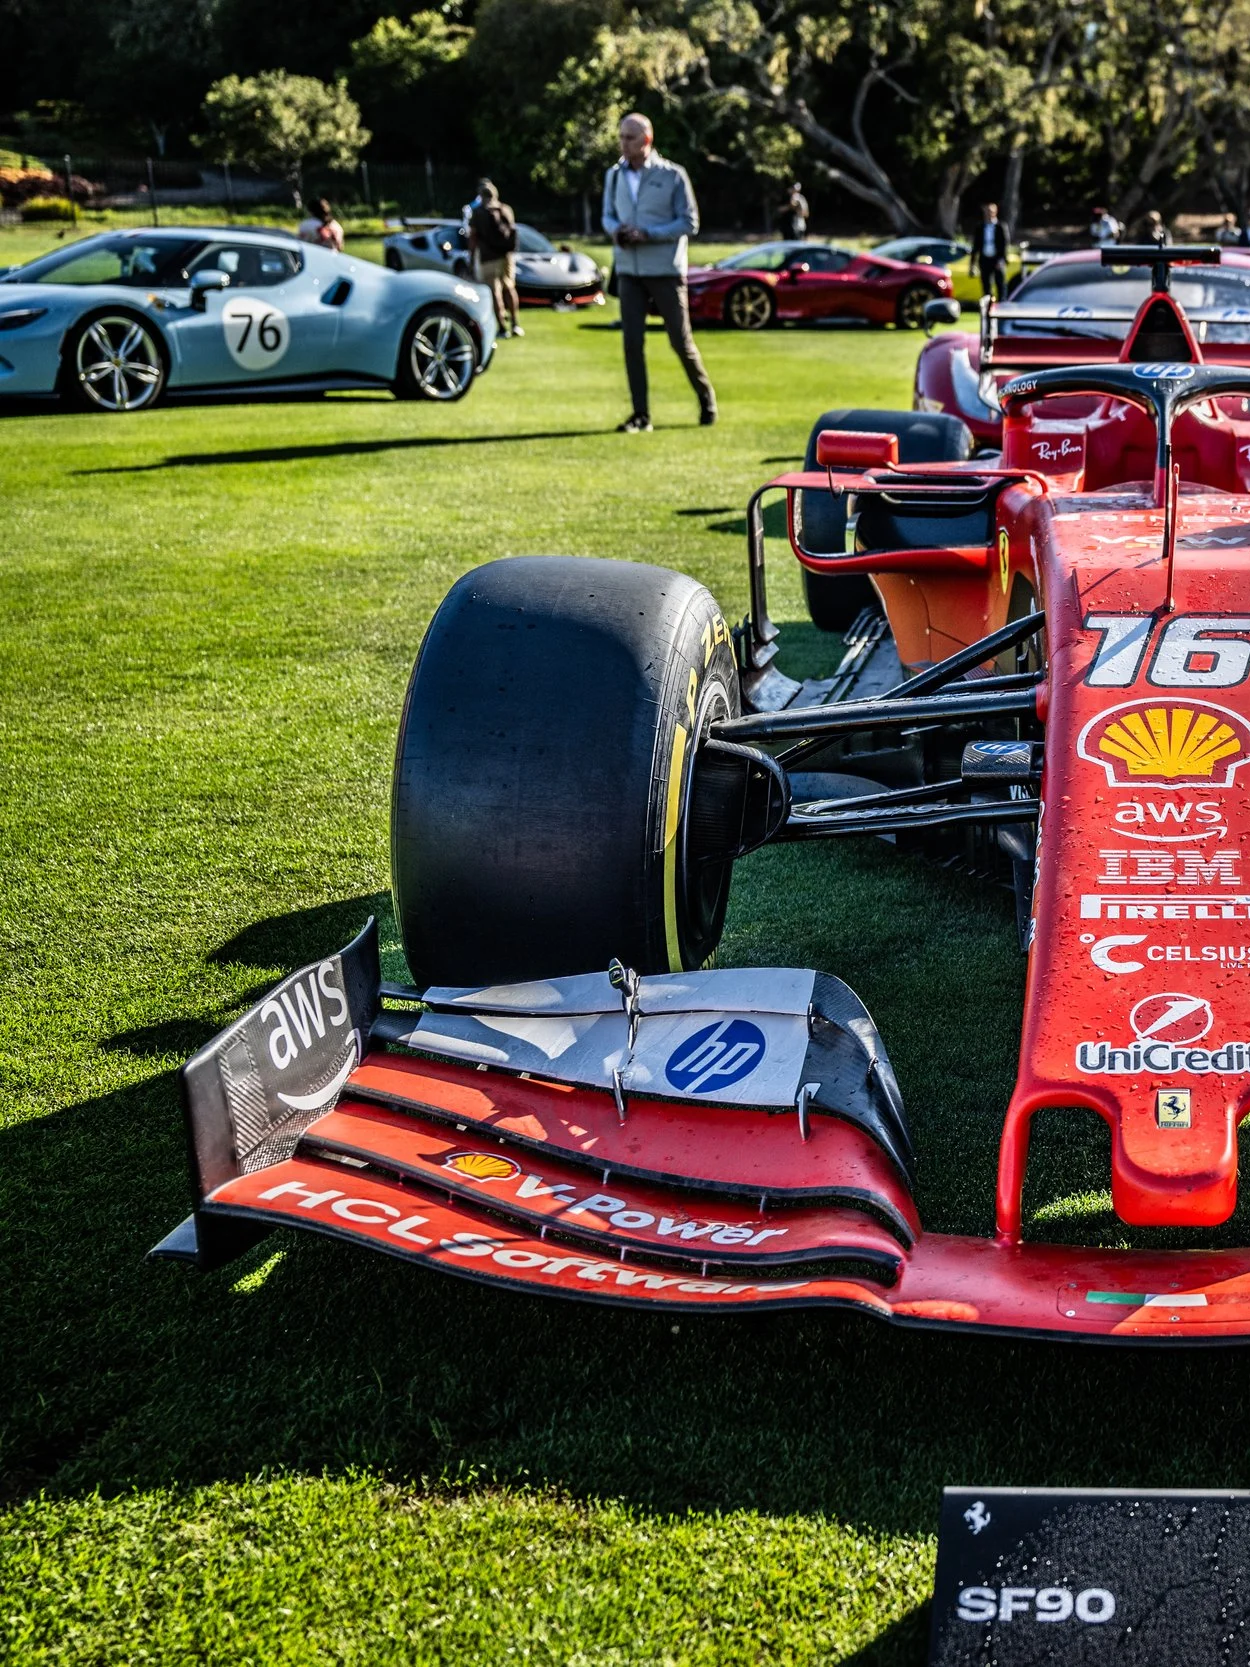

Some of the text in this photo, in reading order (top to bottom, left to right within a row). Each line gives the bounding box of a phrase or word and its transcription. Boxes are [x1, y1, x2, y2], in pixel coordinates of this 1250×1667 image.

[230, 312, 281, 353] 76
[701, 612, 738, 671] ZER
[1115, 802, 1222, 823] aws
[1098, 849, 1242, 885] IBM
[260, 961, 348, 1070] aws
[670, 1019, 760, 1095] hp
[515, 1174, 788, 1246] V-Power
[957, 1587, 1116, 1622] SF90
